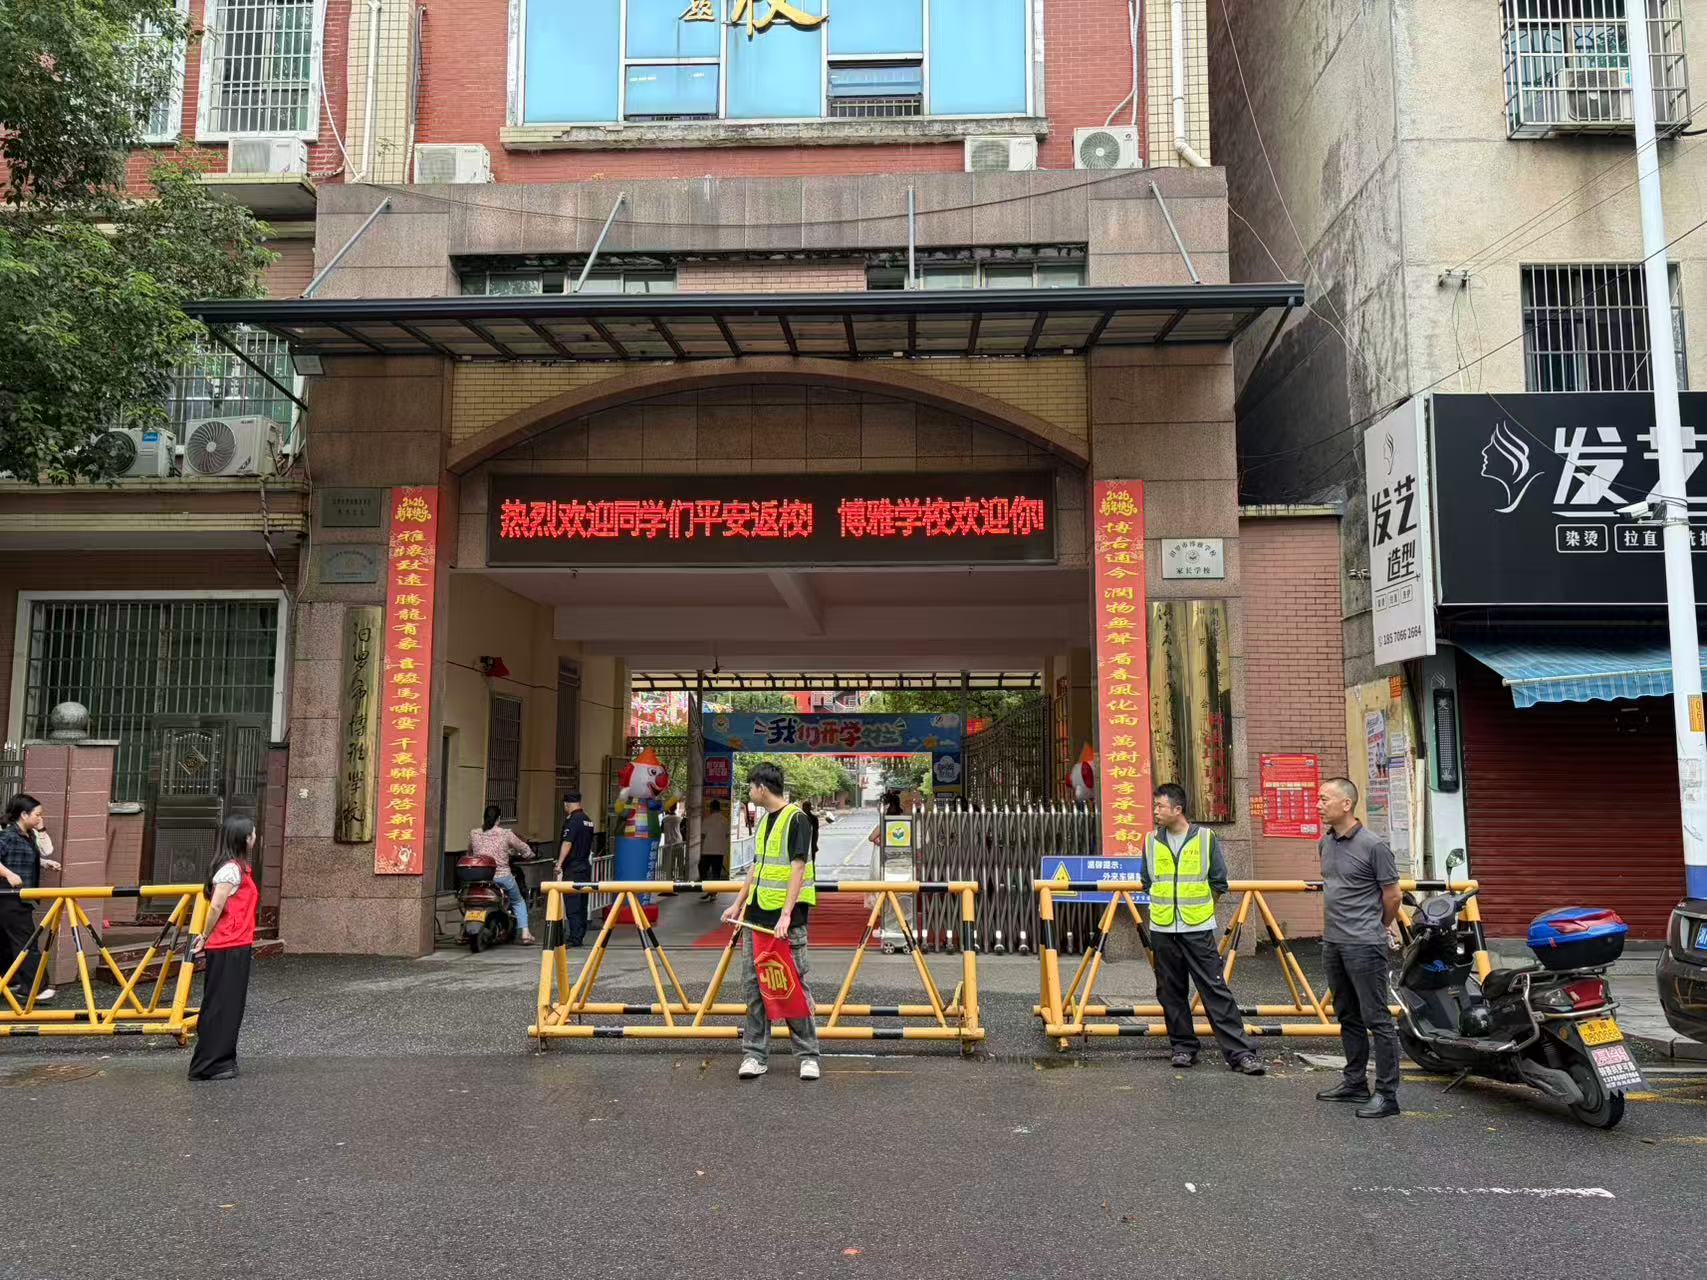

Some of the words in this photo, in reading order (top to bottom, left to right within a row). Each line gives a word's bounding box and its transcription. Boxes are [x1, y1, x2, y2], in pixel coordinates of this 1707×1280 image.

[500, 499, 813, 537] 热烈欢迎同学们平安返校
[838, 497, 1044, 536] 博雅学校欢迎你
[1372, 474, 1417, 547] 发艺
[1566, 530, 1598, 547] 染烫
[1624, 530, 1658, 547] 拉直
[1387, 540, 1415, 581] 造型
